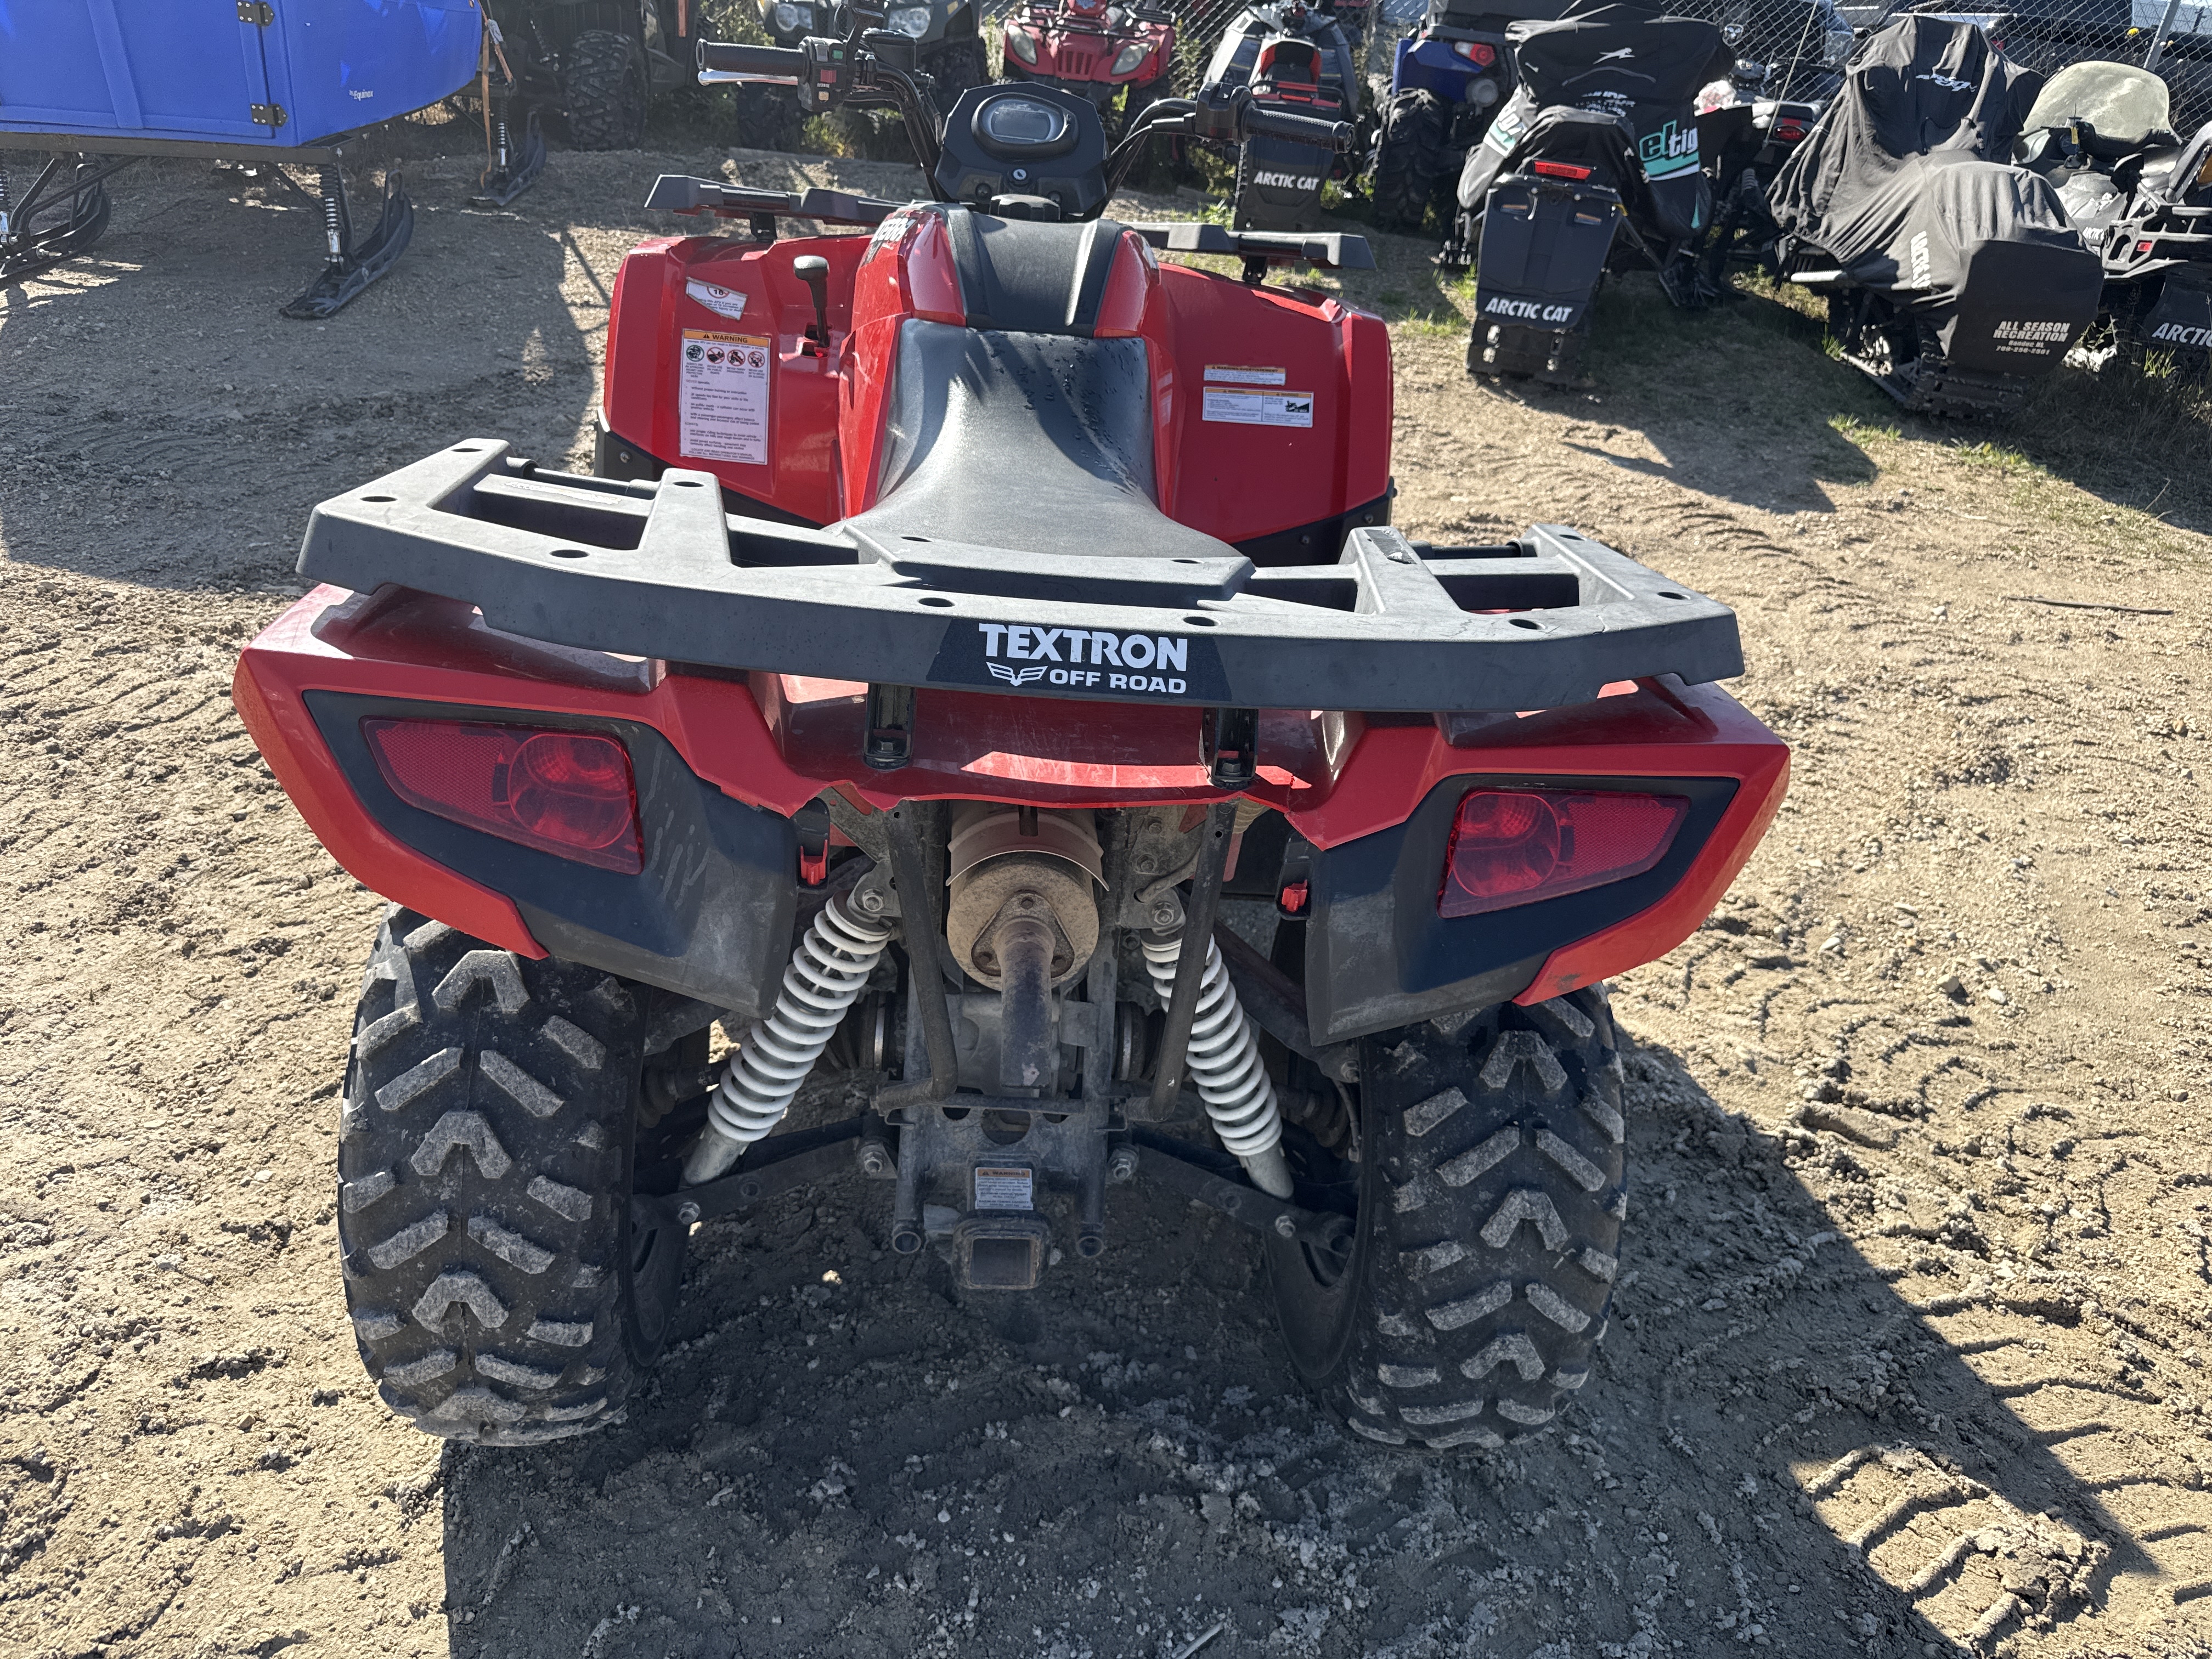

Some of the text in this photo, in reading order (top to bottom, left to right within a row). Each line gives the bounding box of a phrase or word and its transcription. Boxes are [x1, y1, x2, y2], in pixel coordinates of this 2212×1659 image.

[354, 89, 374, 101] Equinox
[1253, 170, 1320, 191] ARCTIC CAT
[1485, 296, 1573, 323] ARCTIC CAT
[1998, 320, 2070, 332] ALL SEASON
[712, 334, 748, 343] WARNING
[1993, 329, 2068, 342] RECREATION
[979, 623, 1188, 672] TEXTRON
[1049, 669, 1187, 694] OFF ROAD
